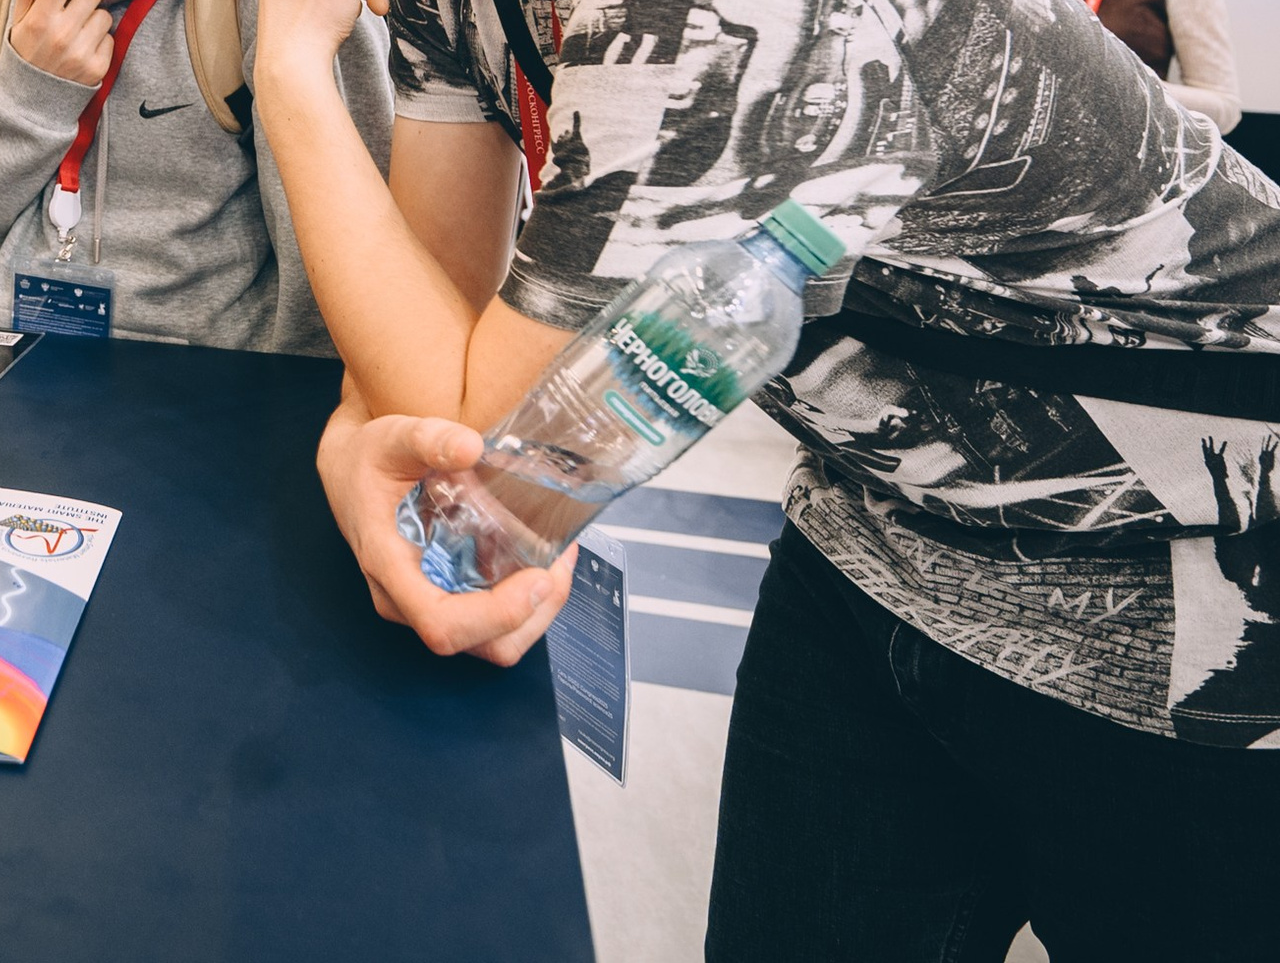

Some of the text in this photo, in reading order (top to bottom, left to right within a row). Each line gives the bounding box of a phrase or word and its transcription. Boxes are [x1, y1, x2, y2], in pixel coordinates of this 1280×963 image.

[612, 317, 719, 427] ЧЕРНОГОЛОВ
[47, 509, 82, 520] SMART
[56, 504, 107, 519] INSTITUTE
